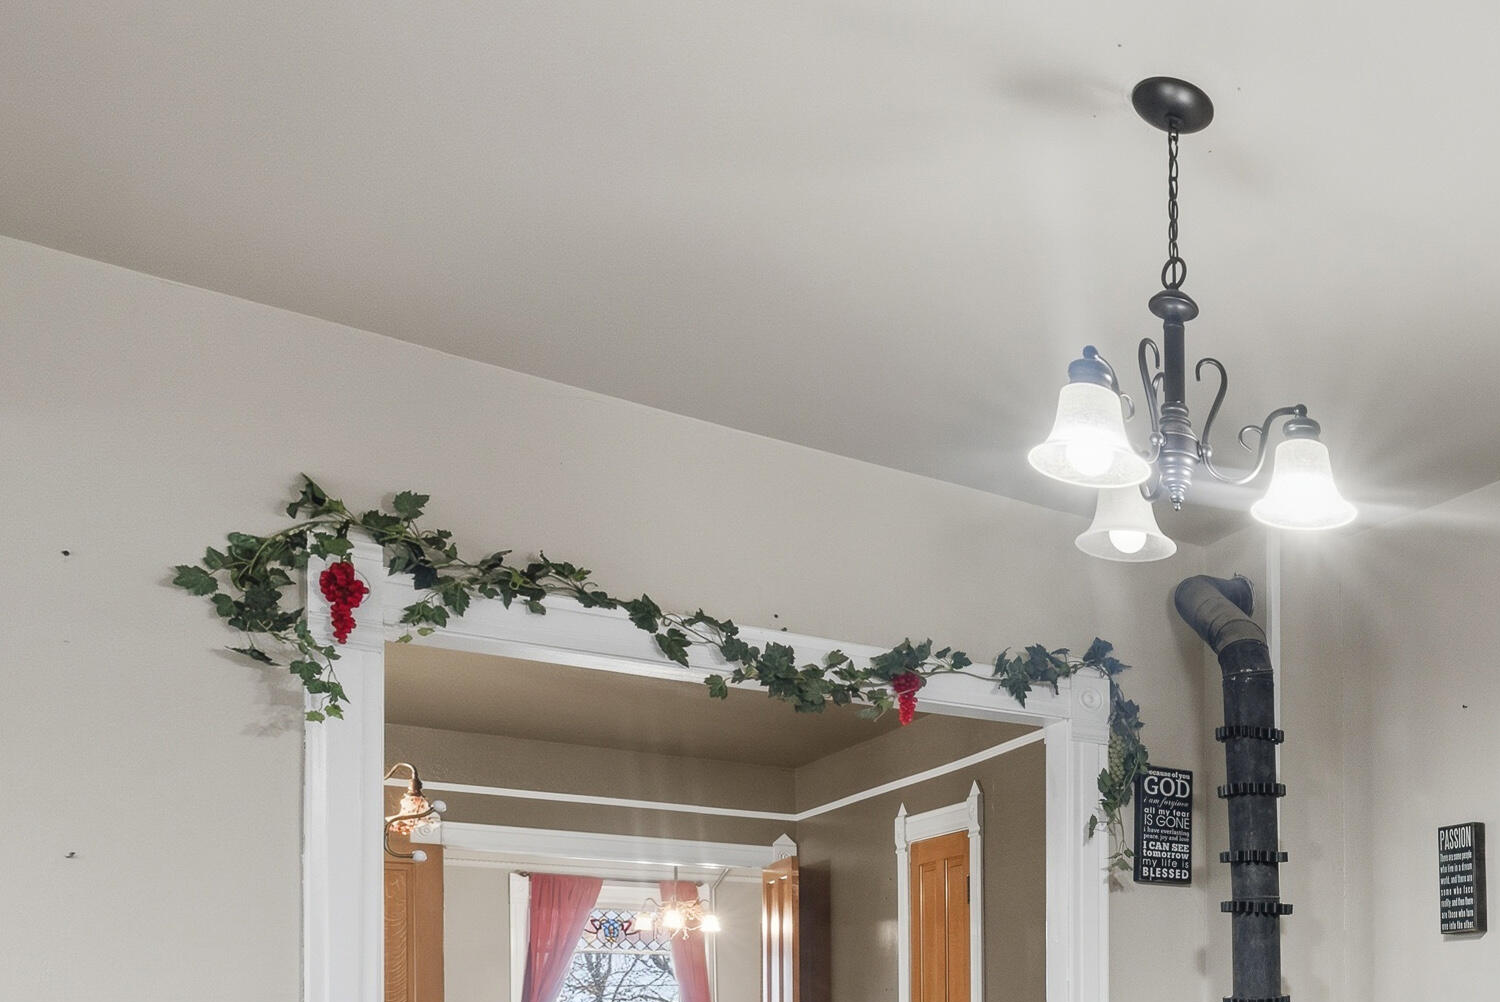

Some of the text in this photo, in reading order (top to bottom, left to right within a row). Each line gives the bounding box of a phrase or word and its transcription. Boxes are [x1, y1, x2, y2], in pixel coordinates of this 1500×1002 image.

[1143, 776, 1190, 798] GOD
[1143, 807, 1190, 818] all my fear
[1144, 813, 1190, 830] IS GONE
[1440, 825, 1472, 851] PASSION
[1148, 841, 1170, 851] CAN
[1171, 843, 1190, 853] SEE
[1142, 848, 1189, 860] tomorrow
[1142, 858, 1189, 869] my life is
[1142, 866, 1190, 880] BLESSED
